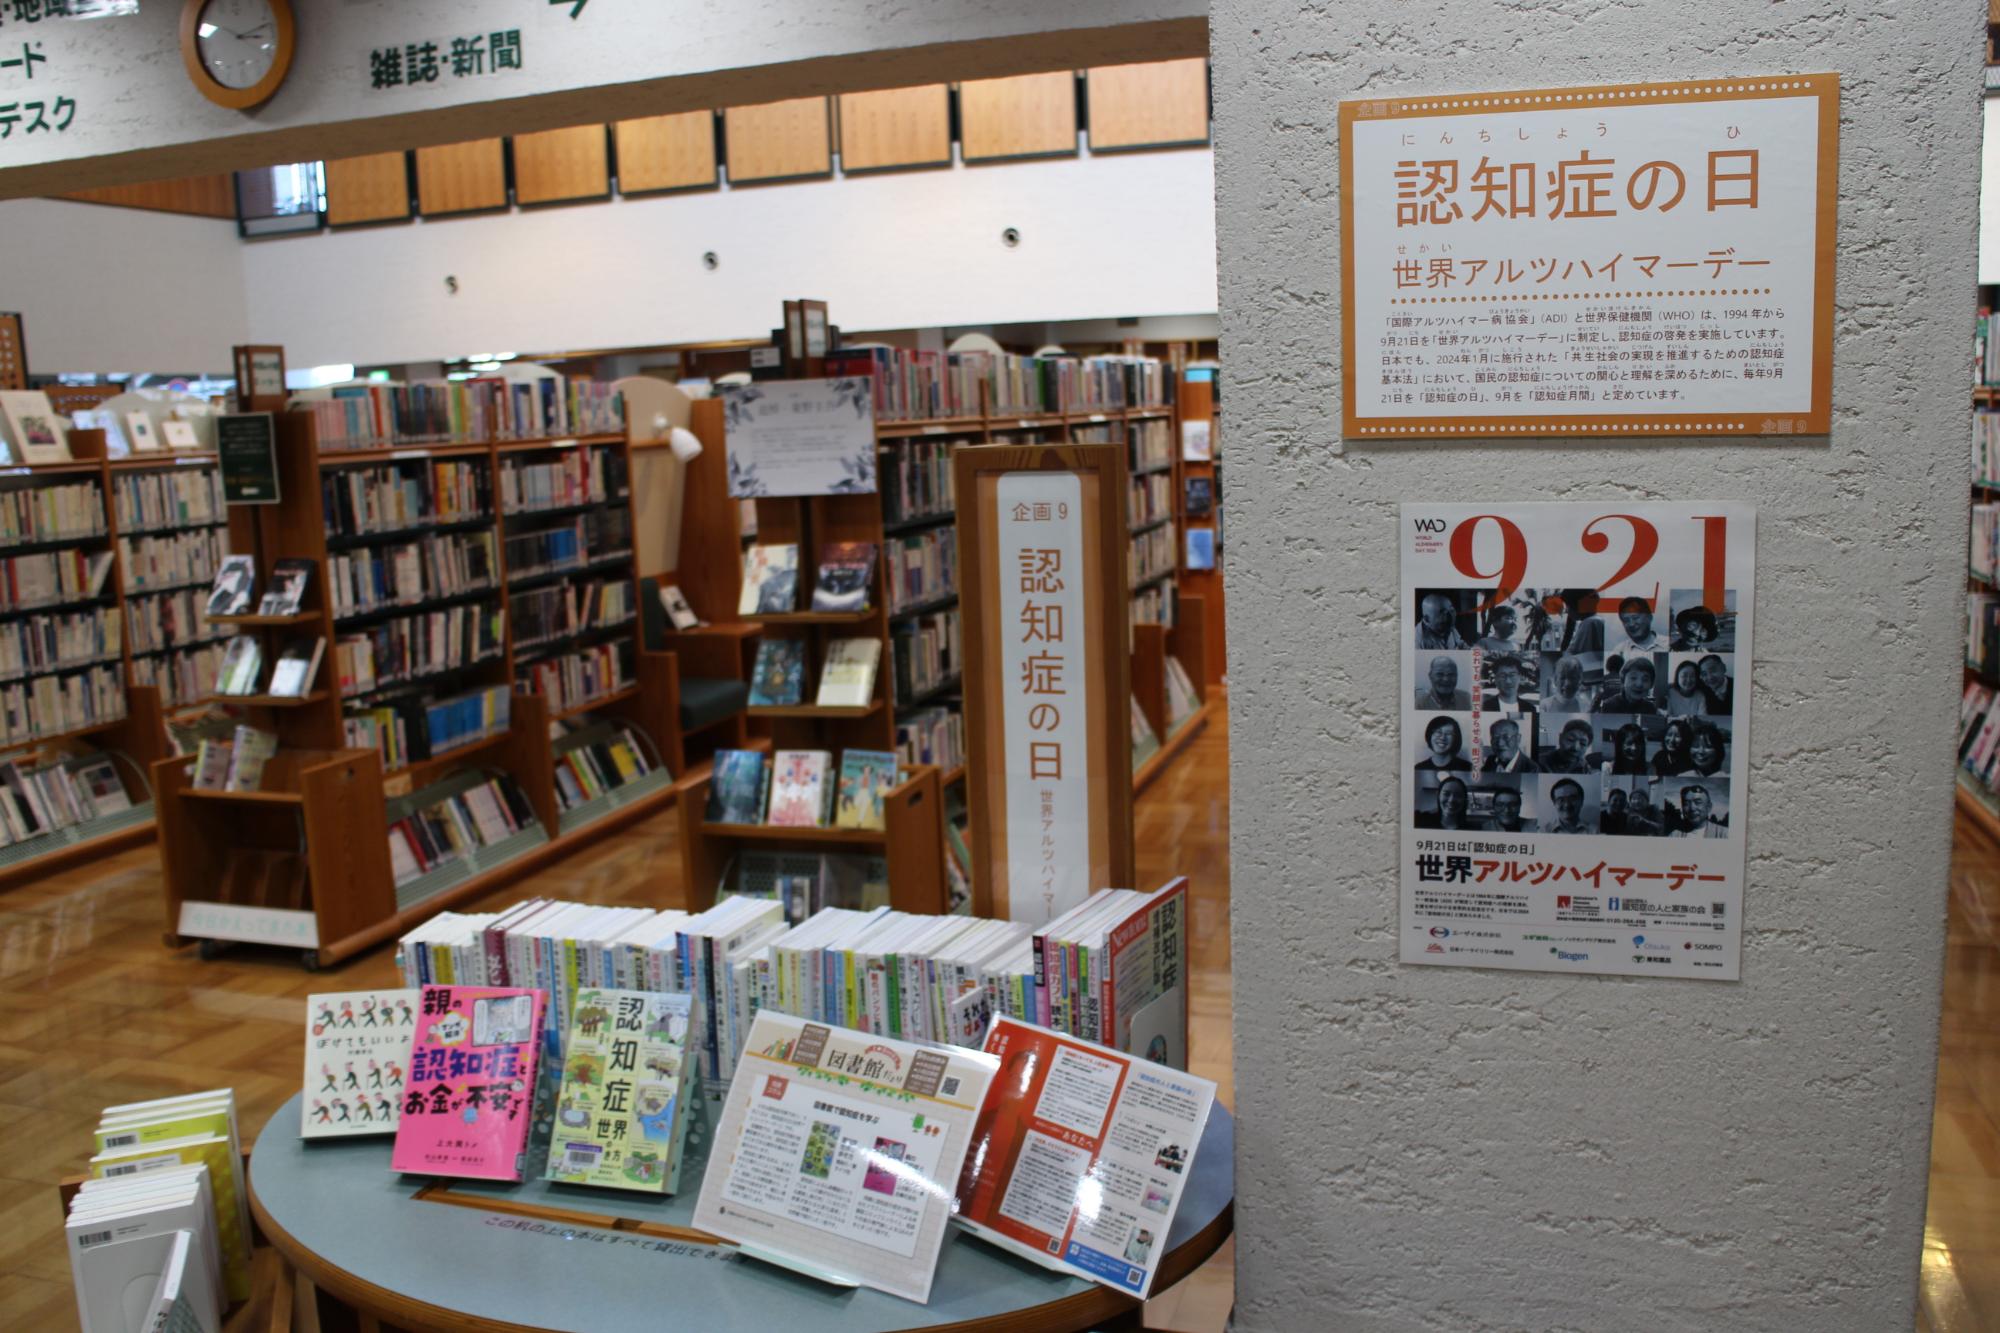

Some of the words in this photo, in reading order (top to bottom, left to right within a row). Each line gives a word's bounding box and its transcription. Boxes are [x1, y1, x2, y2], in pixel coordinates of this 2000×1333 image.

[370, 29, 523, 90] 雑誌・新聞
[1402, 122, 1608, 146] にんちしょう
[1726, 124, 1741, 139] ひ
[1393, 149, 1760, 228] 認知症の日
[1397, 242, 1453, 254] せかい
[1392, 247, 1771, 290] 世界アルツハイマーデー
[1012, 502, 1051, 522] 企画
[1058, 502, 1068, 520] 9
[1414, 519, 1446, 533] WAD
[1449, 514, 1738, 615] 9.21
[1018, 548, 1066, 781] 認知症の日
[1040, 789, 1056, 920] 世界アルツハイマー
[1416, 841, 1535, 855] 9月21日は「認知症の日」
[1415, 854, 1726, 892] 世界アルツハイマーデー
[1622, 901, 1706, 914] 認知症の人と家族の会
[1558, 951, 1588, 961] Biogen
[1694, 943, 1723, 951] SOMPO
[423, 988, 462, 1015] 親の
[412, 1046, 526, 1083] 認知症と
[602, 997, 644, 1113] 認知症
[596, 1118, 628, 1141] 世界
